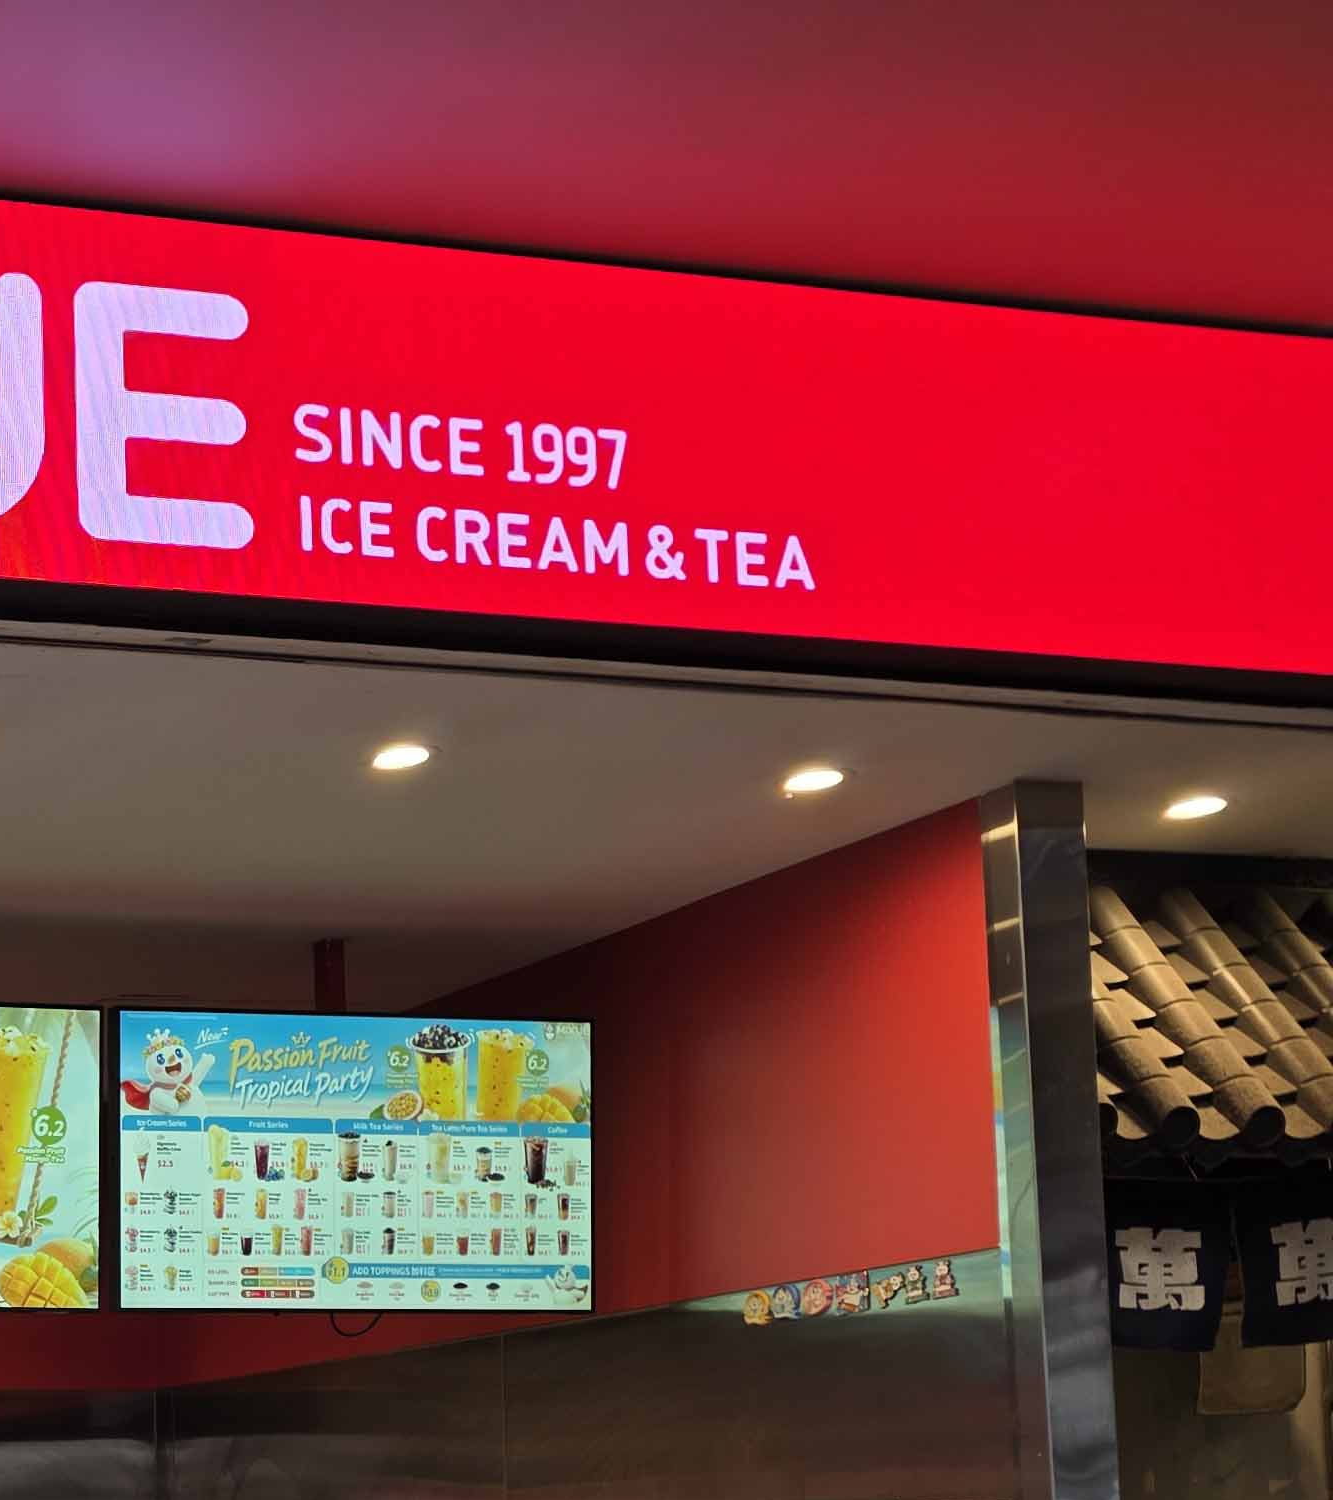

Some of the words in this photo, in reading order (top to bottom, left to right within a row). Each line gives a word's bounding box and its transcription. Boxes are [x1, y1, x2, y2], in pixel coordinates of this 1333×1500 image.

[293, 403, 485, 477] SINCE
[504, 420, 628, 490] 1997
[299, 494, 395, 558] ICE
[415, 506, 630, 577] CREAM
[644, 524, 687, 581] &
[693, 528, 817, 591] TEA
[197, 1030, 223, 1043] New
[228, 1038, 314, 1097] Passion
[317, 1036, 371, 1069] Fruit
[235, 1072, 311, 1110] Tropical
[313, 1065, 375, 1108] Party
